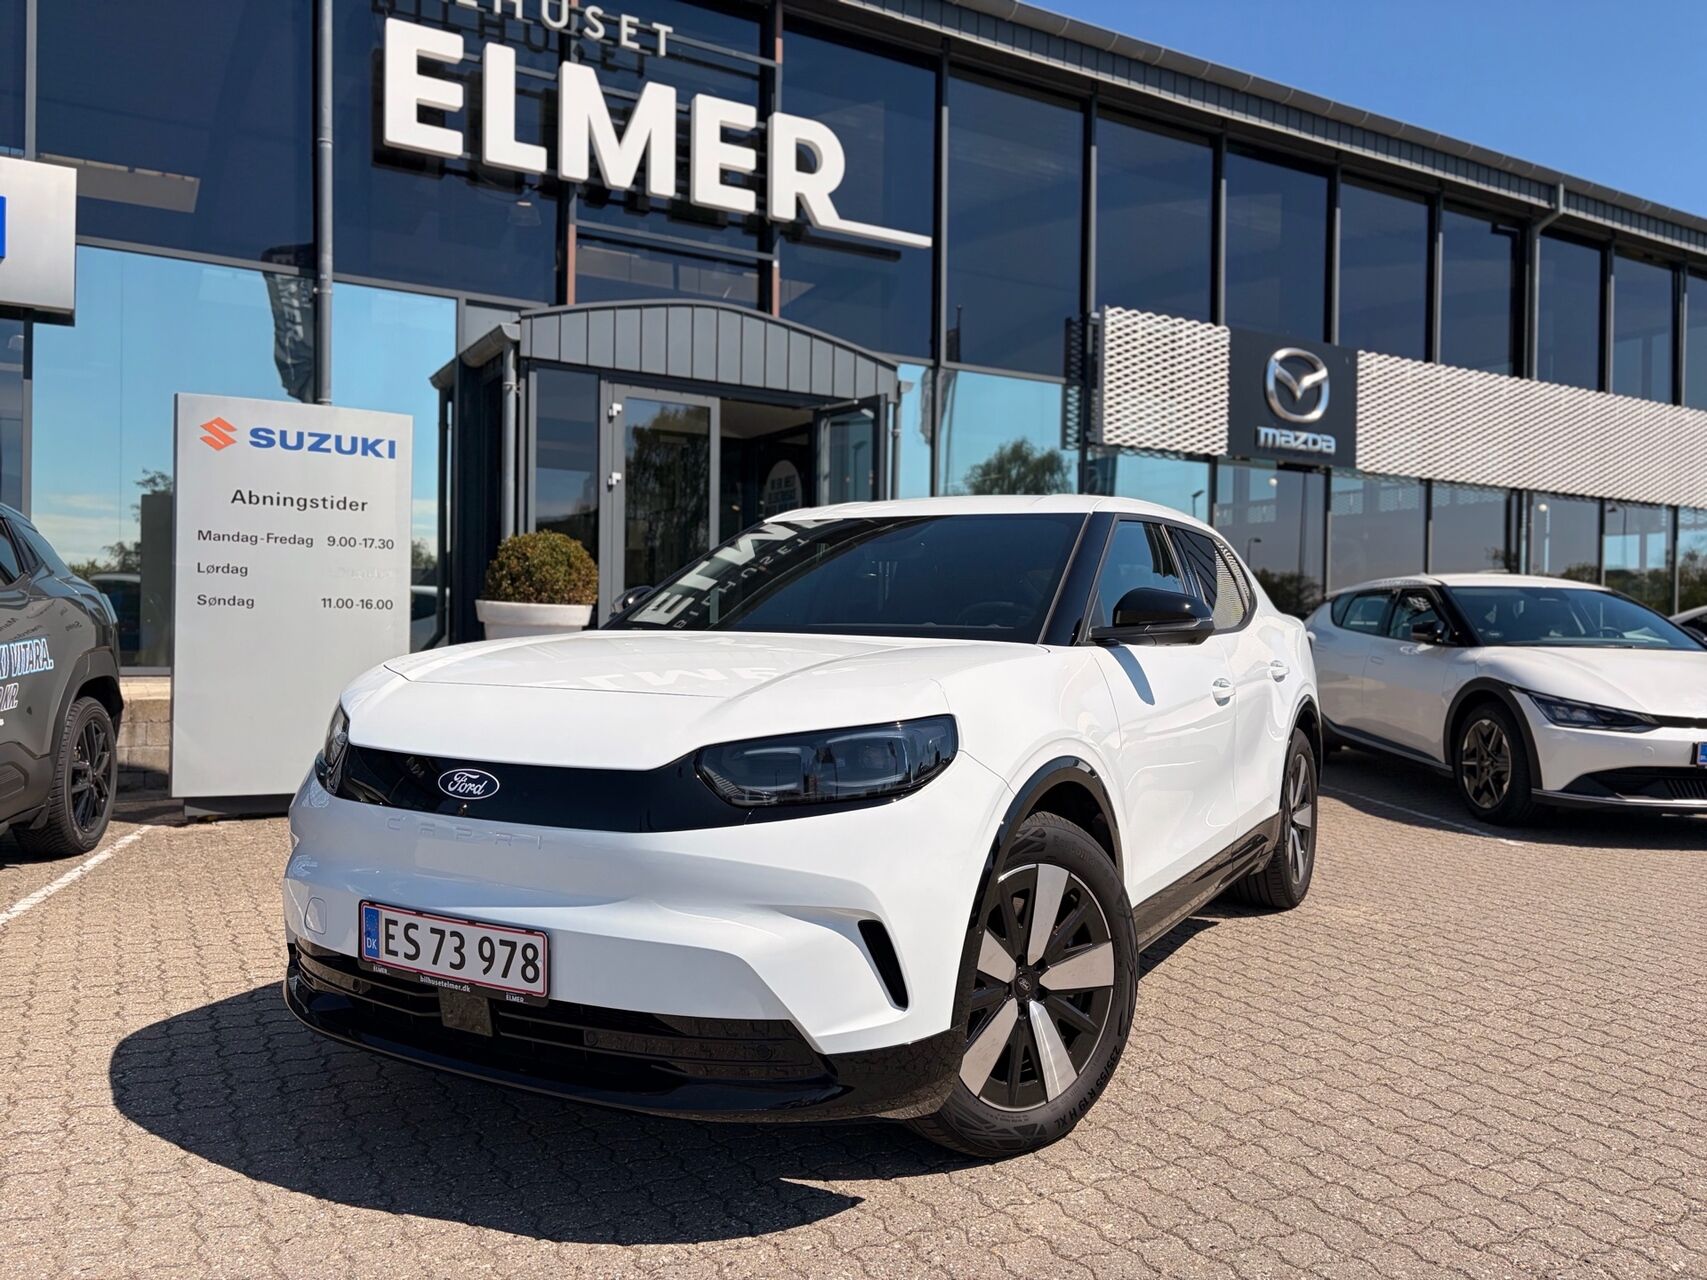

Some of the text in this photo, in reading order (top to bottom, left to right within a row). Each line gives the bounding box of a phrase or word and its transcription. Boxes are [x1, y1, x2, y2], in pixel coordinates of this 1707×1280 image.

[383, 17, 932, 248] ELMER
[249, 427, 396, 459] SUZUKI
[1257, 426, 1336, 454] mazda
[231, 489, 368, 511] Abningstider
[327, 536, 394, 550] 9.00-17.30
[197, 562, 249, 577] Lørdag
[197, 594, 394, 610] Søndag 11.00-16.00
[447, 772, 488, 796] Ford
[386, 817, 543, 850] CAPRI
[366, 937, 378, 951] DK
[384, 917, 541, 984] ES 73 978
[419, 975, 471, 993] bilhusetelmer.dk
